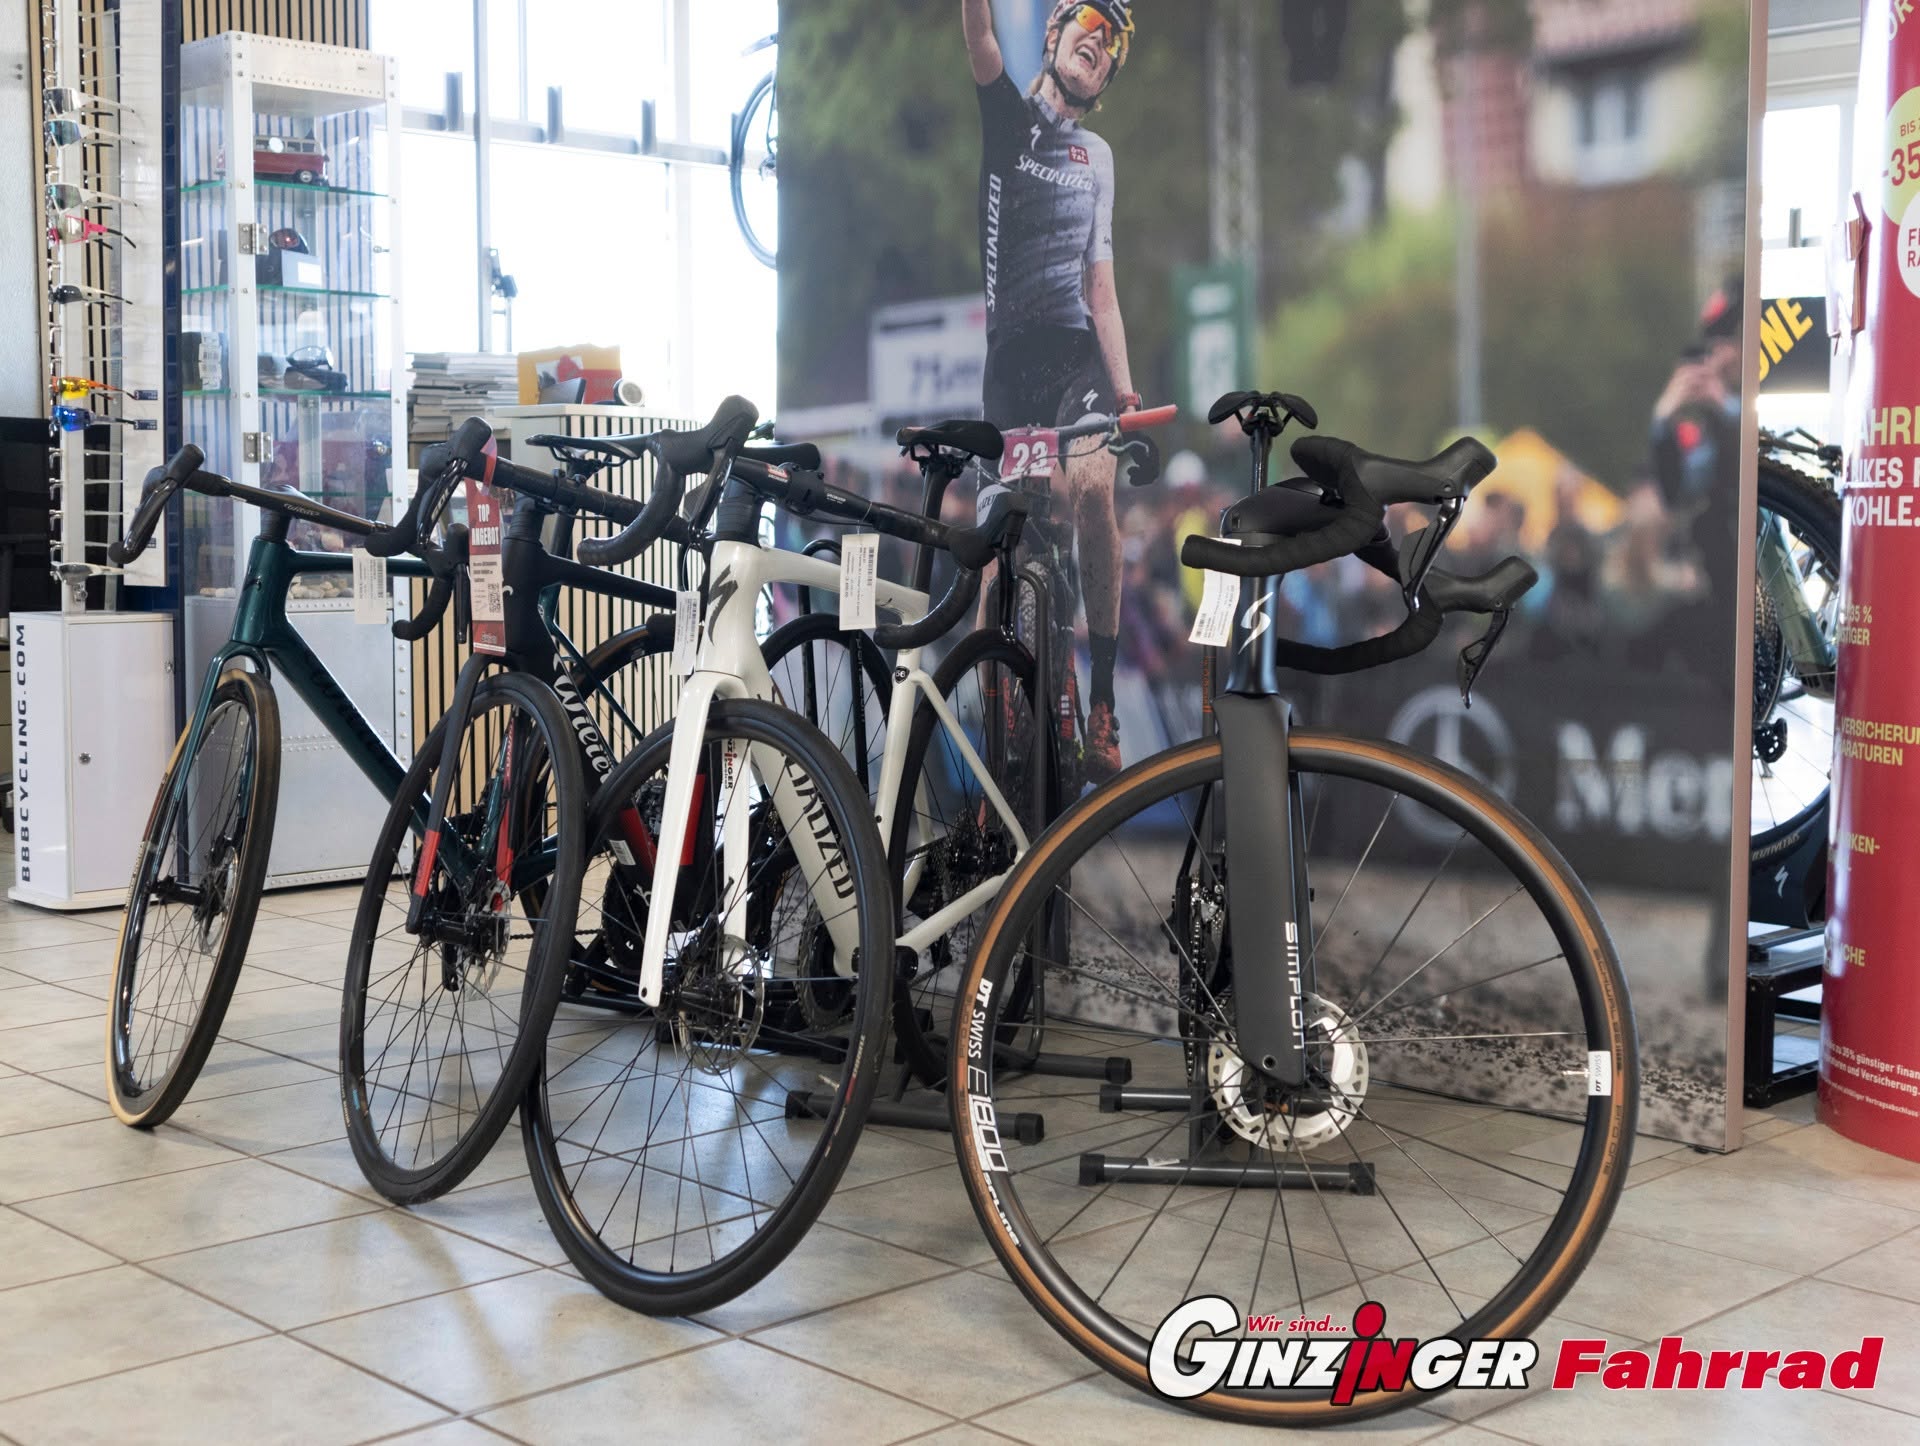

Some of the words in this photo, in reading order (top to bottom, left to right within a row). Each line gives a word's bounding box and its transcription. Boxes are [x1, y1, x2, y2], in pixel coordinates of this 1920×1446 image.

[1015, 153, 1094, 192] SPECIALIZED
[986, 173, 1002, 313] SPECIALIZED
[478, 503, 490, 522] TOP
[472, 526, 500, 546] ANGEBOT
[16, 624, 31, 882] BBBCYCLING.COM
[975, 977, 994, 1008] DT
[1285, 921, 1305, 1050] SIMPLON
[968, 1010, 987, 1059] SWISS
